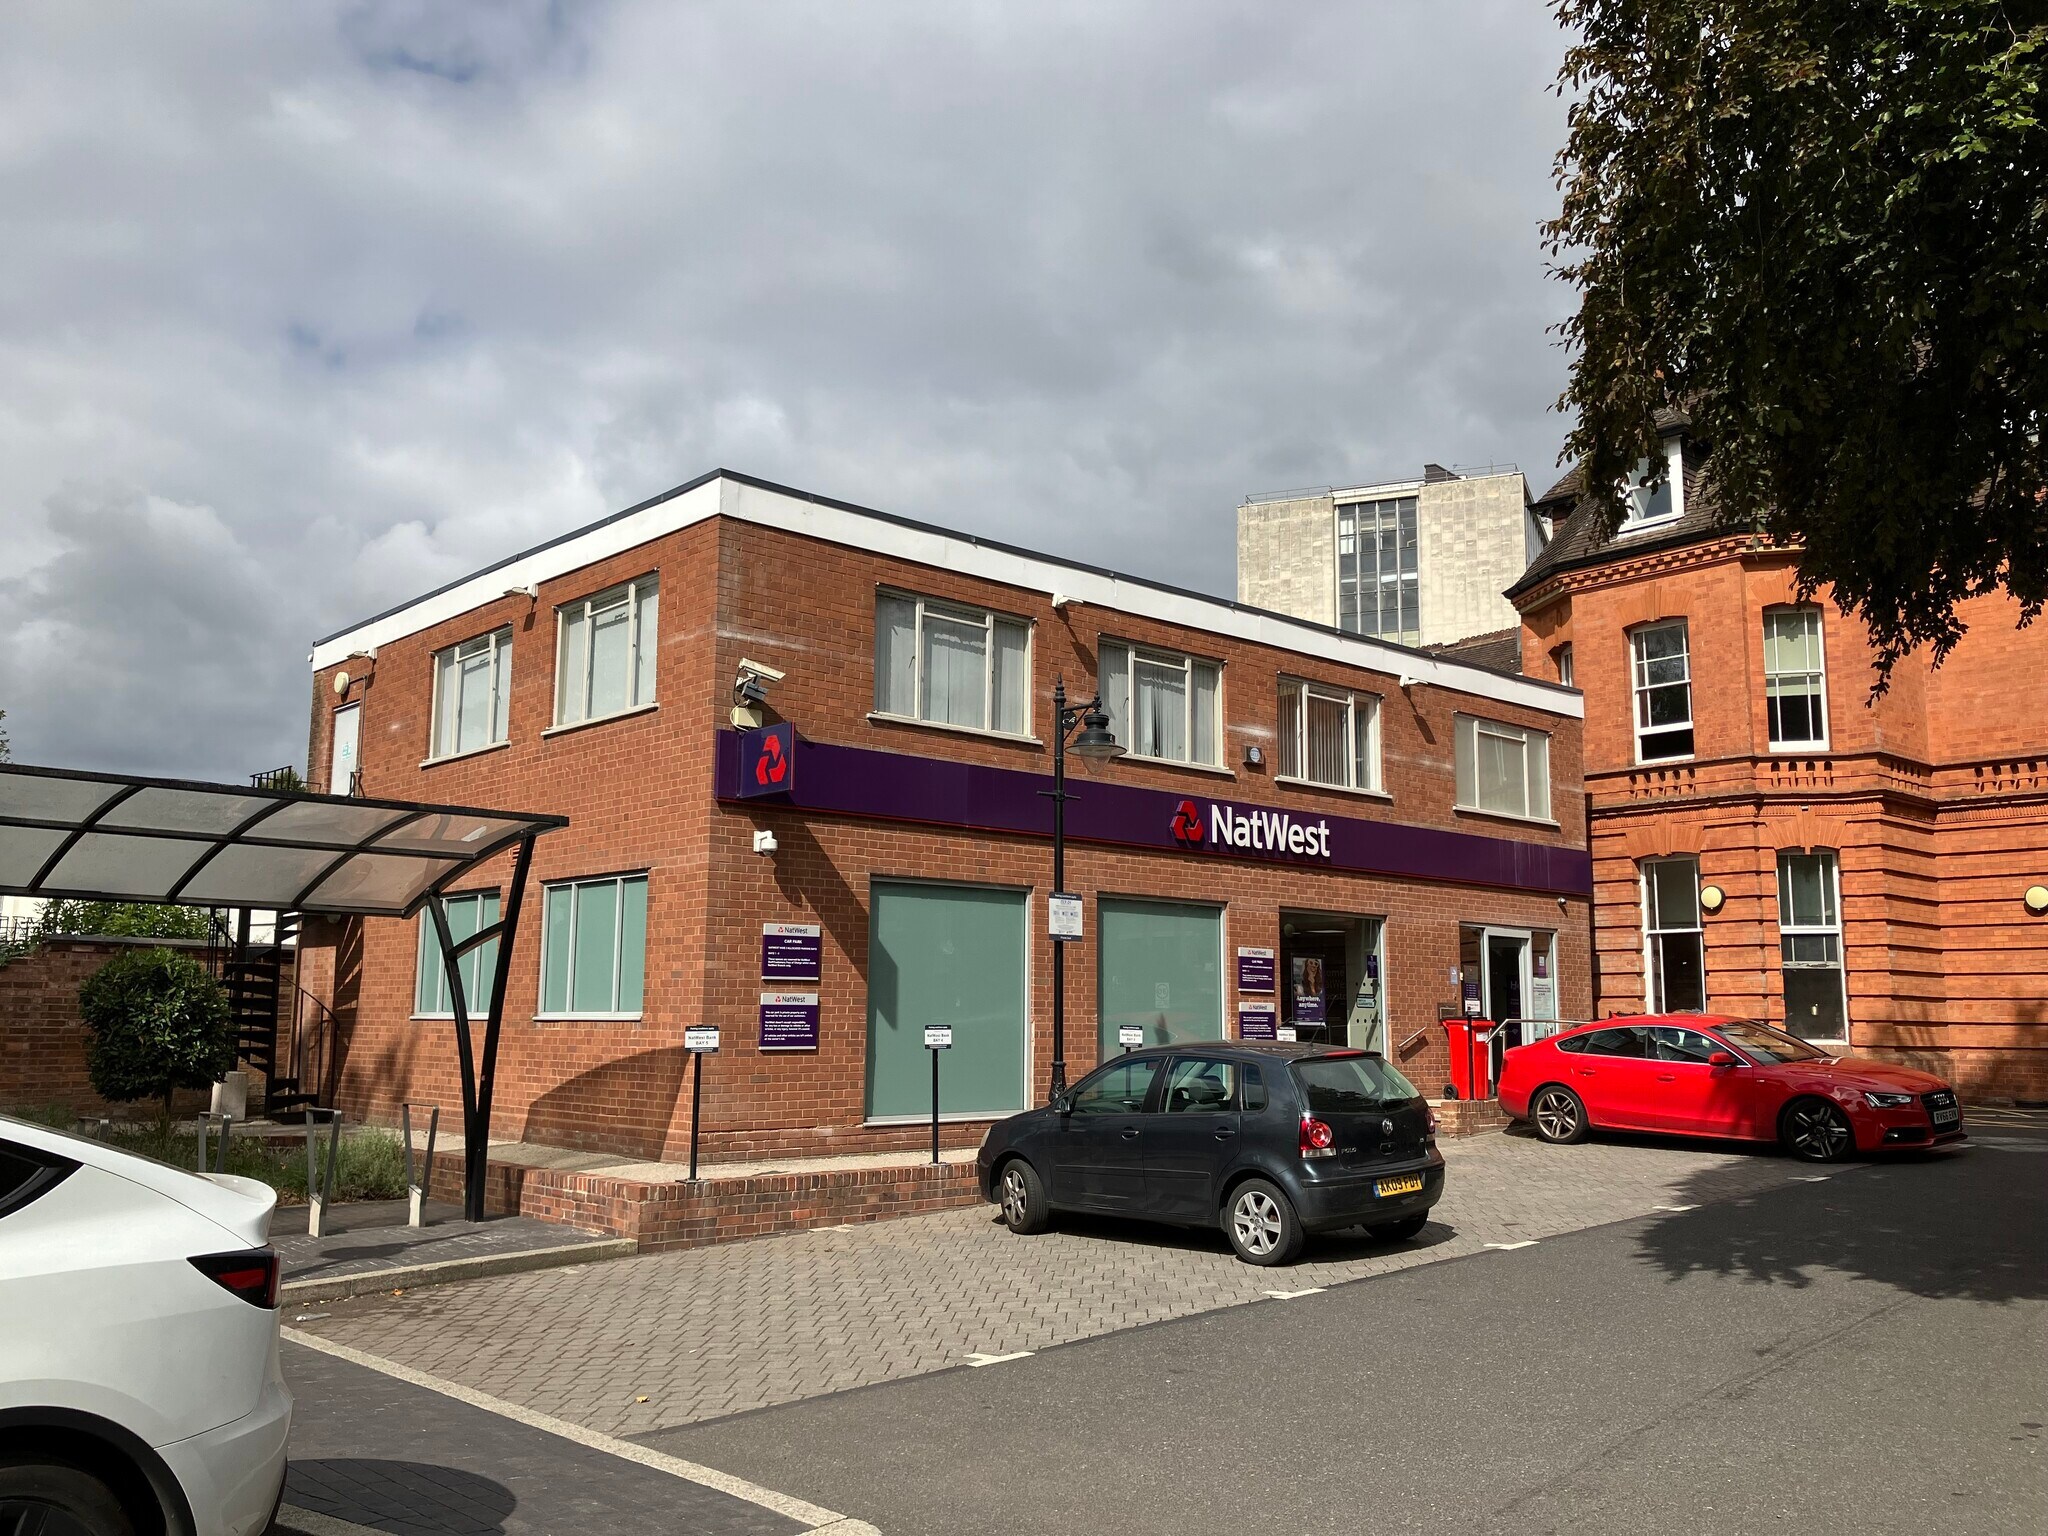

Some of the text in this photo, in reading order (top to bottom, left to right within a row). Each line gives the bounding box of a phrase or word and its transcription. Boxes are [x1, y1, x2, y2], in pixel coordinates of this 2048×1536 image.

[1210, 804, 1331, 857] NatWest
[784, 926, 808, 935] NatWest
[1380, 1173, 1419, 1194] AK09 FDY
